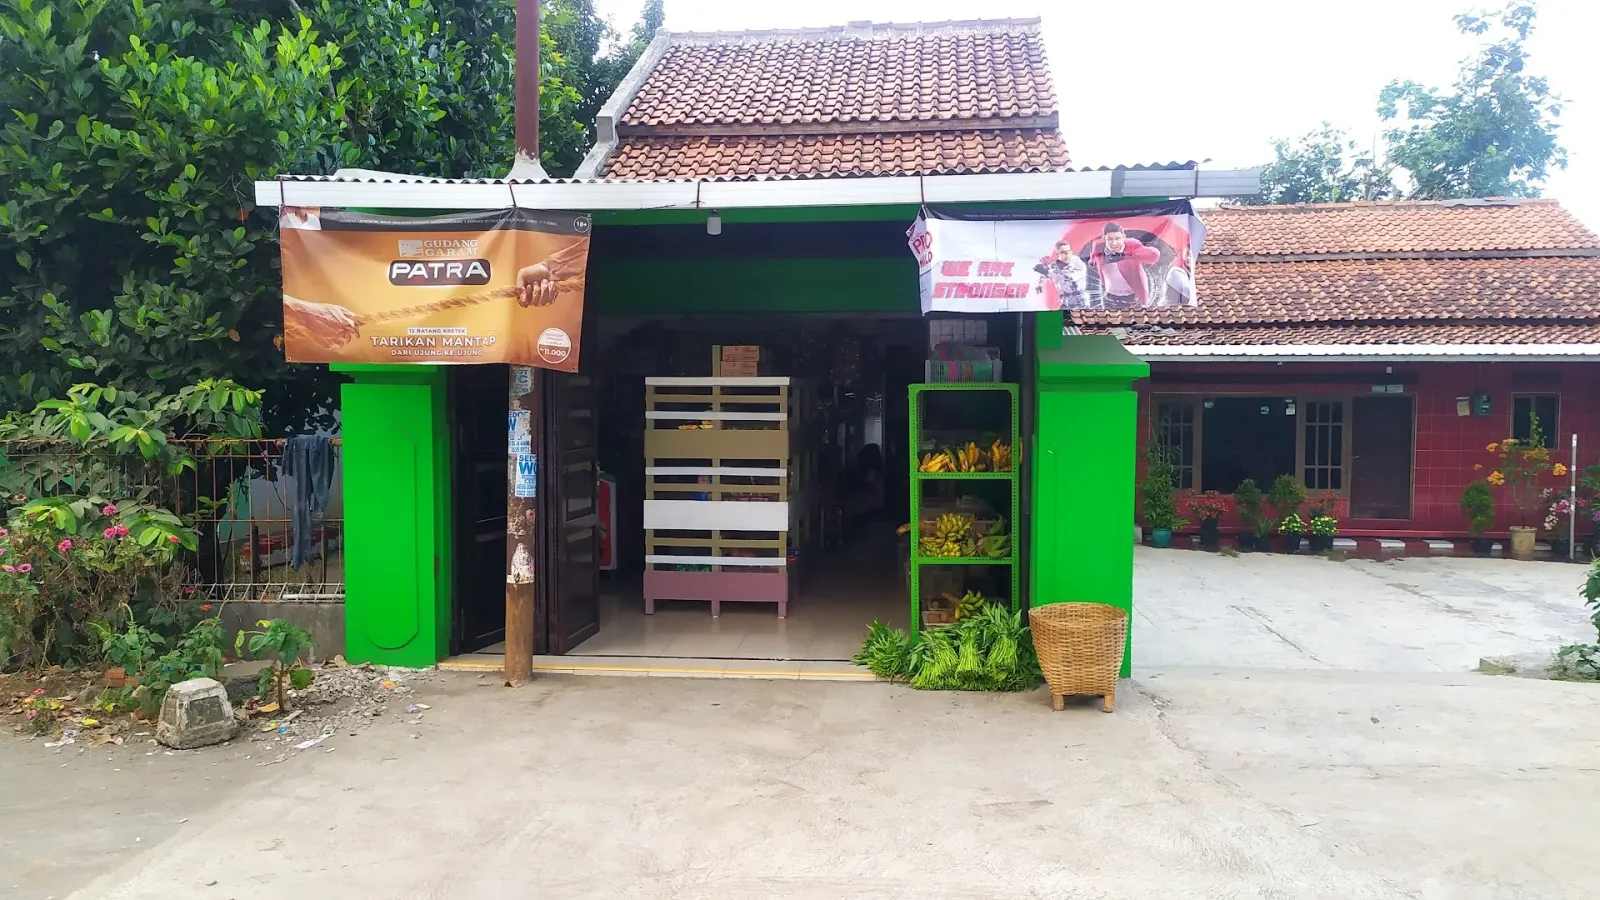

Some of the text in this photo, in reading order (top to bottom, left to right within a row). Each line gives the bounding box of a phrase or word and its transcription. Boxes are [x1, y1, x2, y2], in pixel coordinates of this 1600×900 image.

[424, 240, 478, 248] GUDANG
[425, 248, 477, 257] GARAM
[391, 261, 488, 279] PATRA
[941, 260, 1015, 277] WE ARE
[931, 282, 1030, 299] STRONGER
[371, 336, 496, 347] TARIKAN MANTAP
[414, 349, 442, 357] UJUNG
[544, 347, 567, 357] 11.000
